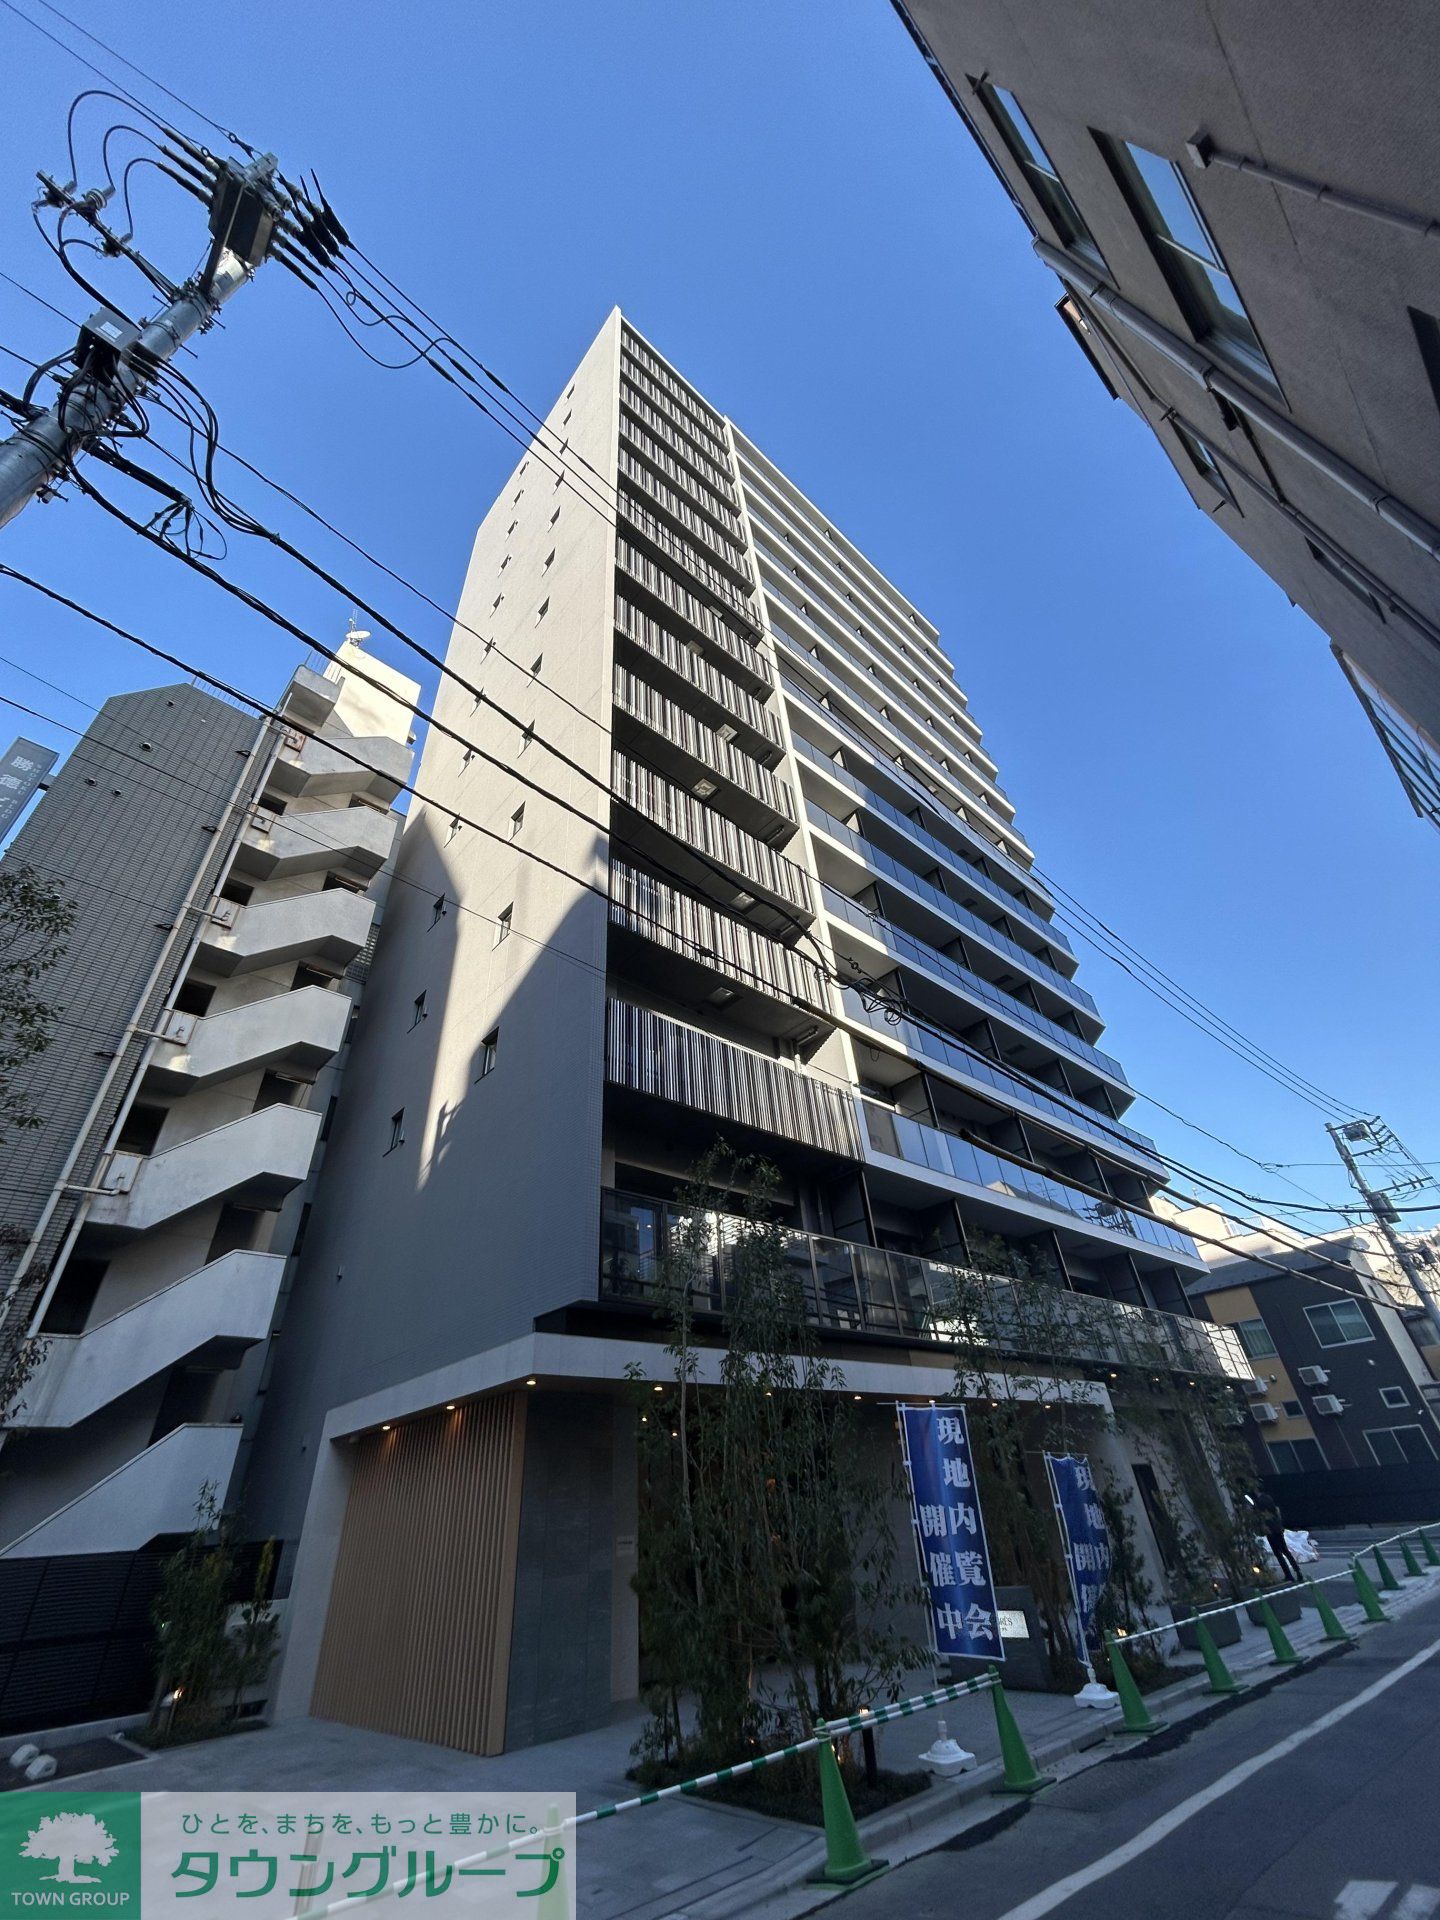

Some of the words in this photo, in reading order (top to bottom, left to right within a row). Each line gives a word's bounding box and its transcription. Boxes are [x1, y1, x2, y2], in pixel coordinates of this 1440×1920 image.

[919, 1503, 965, 1640] 開催中
[936, 1416, 994, 1641] 現地内覧会
